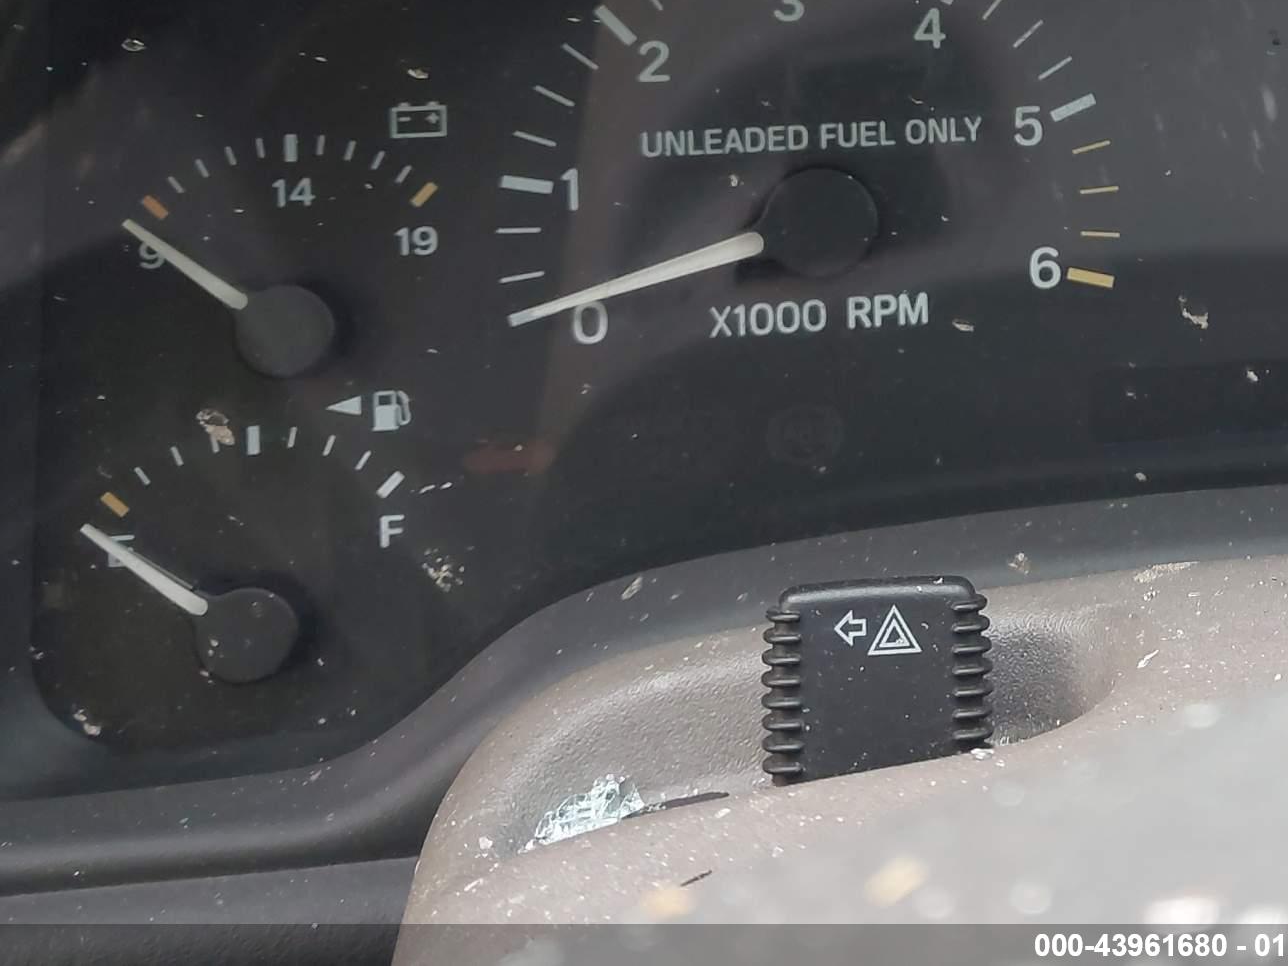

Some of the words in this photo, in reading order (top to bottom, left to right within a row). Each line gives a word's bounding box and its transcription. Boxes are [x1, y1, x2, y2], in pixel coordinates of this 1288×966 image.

[913, 7, 947, 49] 4
[638, 40, 671, 83] 2
[639, 124, 809, 158] UNLEADED
[819, 120, 897, 150] FUEL
[905, 116, 982, 145] ONLY
[1014, 105, 1043, 147] 5
[271, 177, 316, 208] 14
[561, 168, 579, 211] 1
[395, 225, 438, 256] 19
[1029, 246, 1062, 289] 6
[572, 298, 609, 344] 0
[709, 301, 827, 338] X1000
[847, 291, 929, 330] RPM
[379, 514, 405, 548] F
